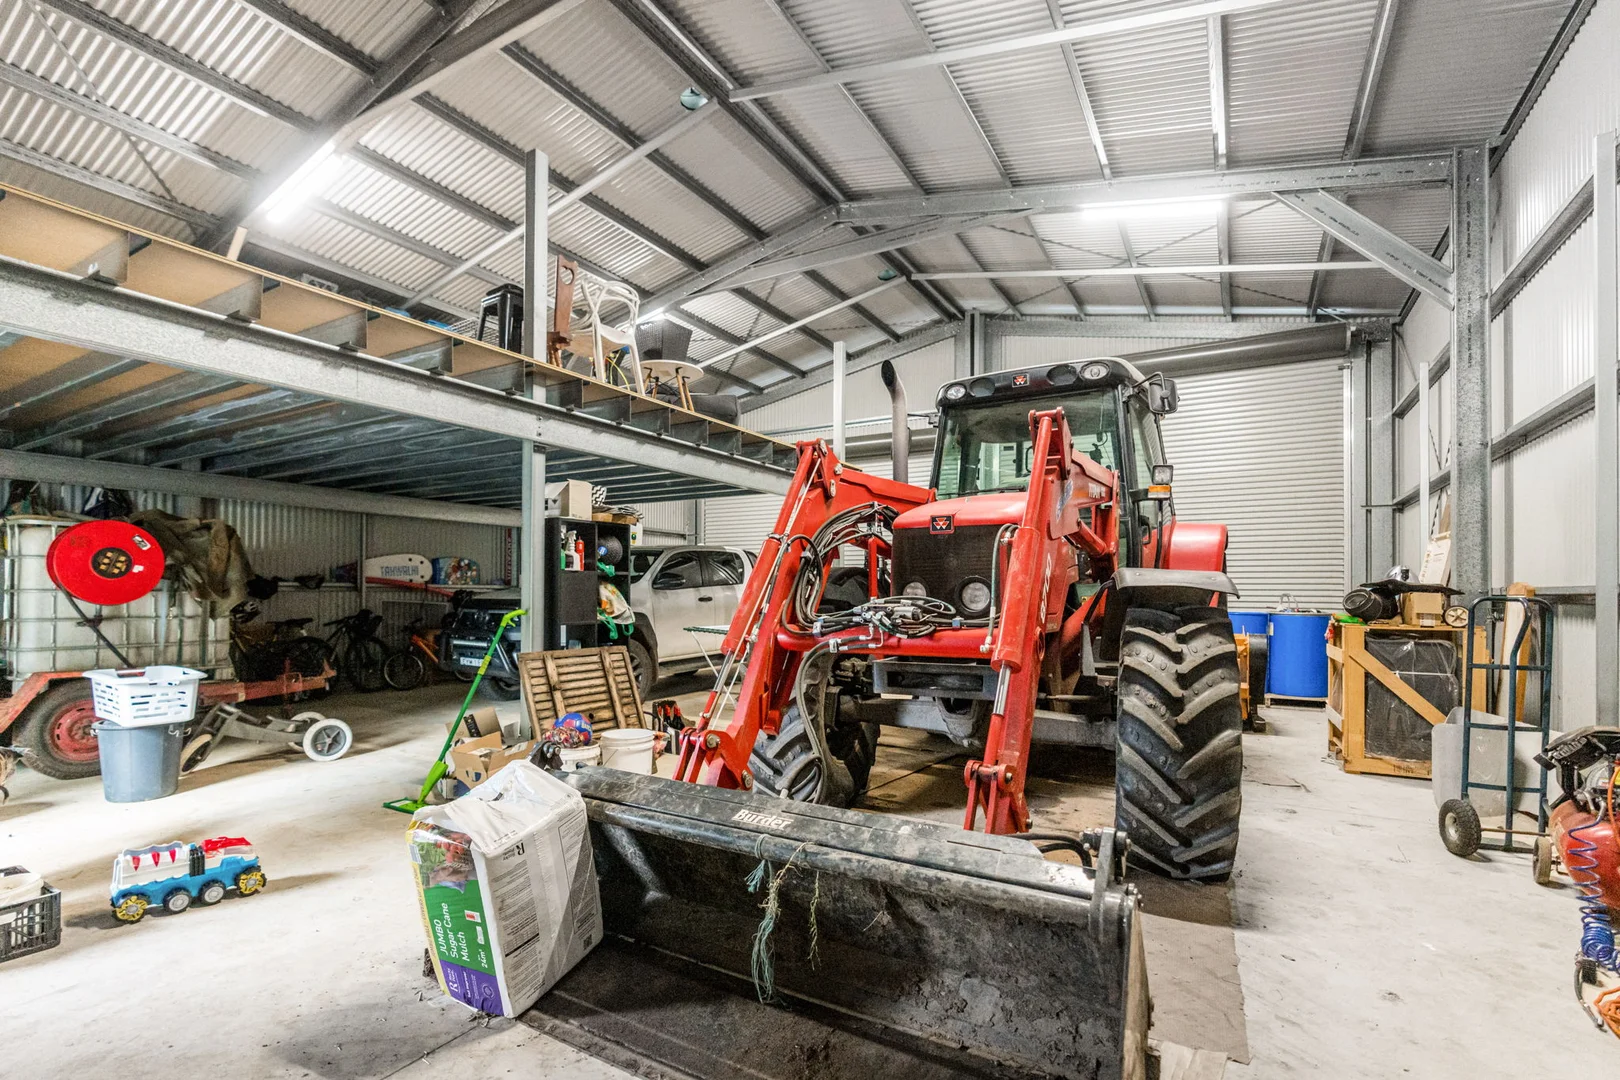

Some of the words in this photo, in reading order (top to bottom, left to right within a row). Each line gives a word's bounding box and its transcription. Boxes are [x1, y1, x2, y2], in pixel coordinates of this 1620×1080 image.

[731, 808, 794, 831] Burder
[441, 902, 452, 927] Cane
[433, 919, 448, 956] JUMBO
[447, 928, 459, 959] Sugar
[457, 931, 470, 962] Mulch
